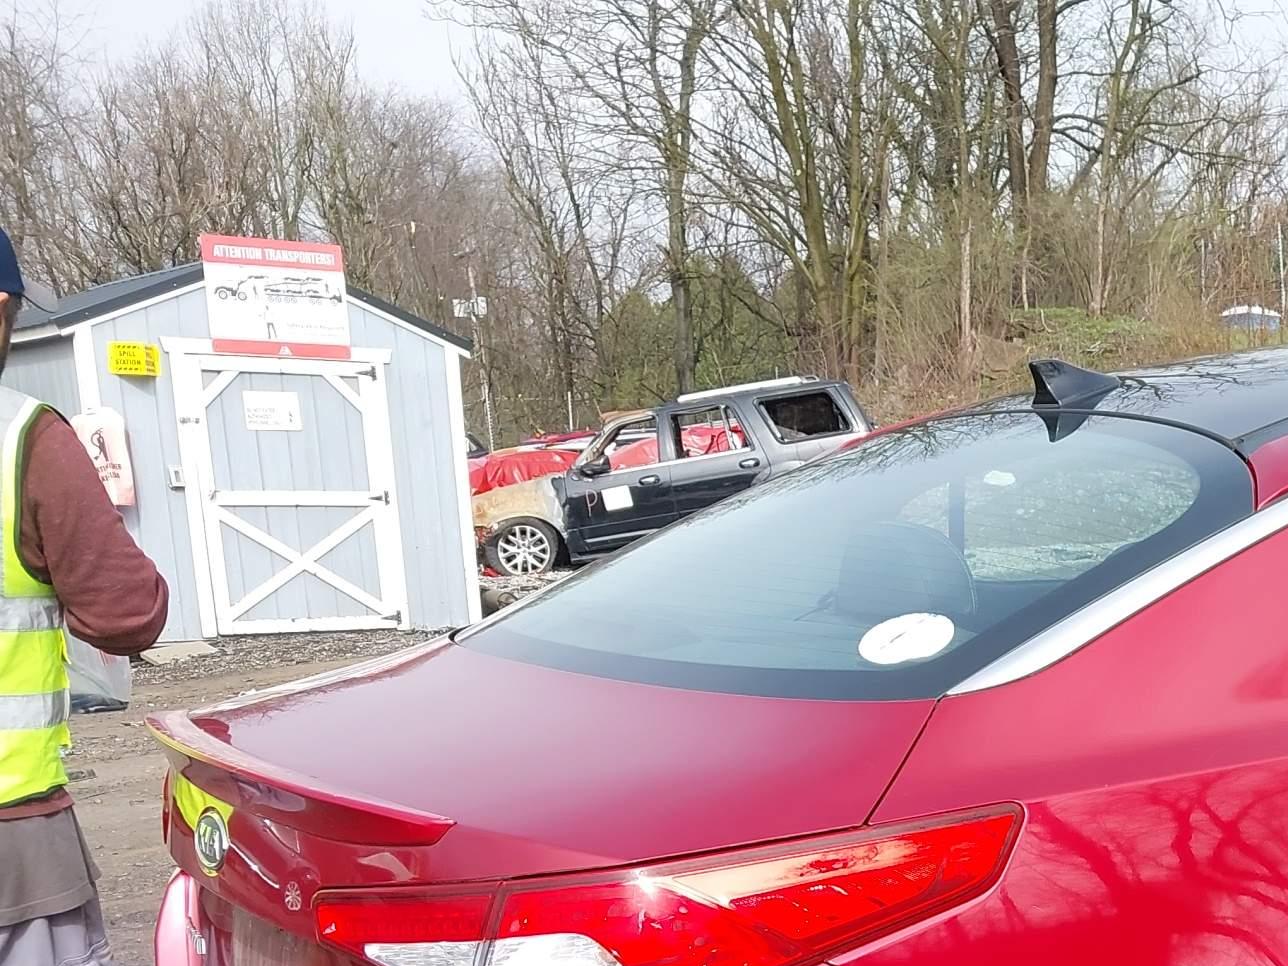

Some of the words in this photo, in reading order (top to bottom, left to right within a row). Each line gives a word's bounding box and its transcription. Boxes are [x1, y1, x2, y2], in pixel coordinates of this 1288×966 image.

[213, 244, 262, 260] ATTENTION
[263, 248, 336, 266] TRANSPORTERS!
[585, 489, 598, 518] P
